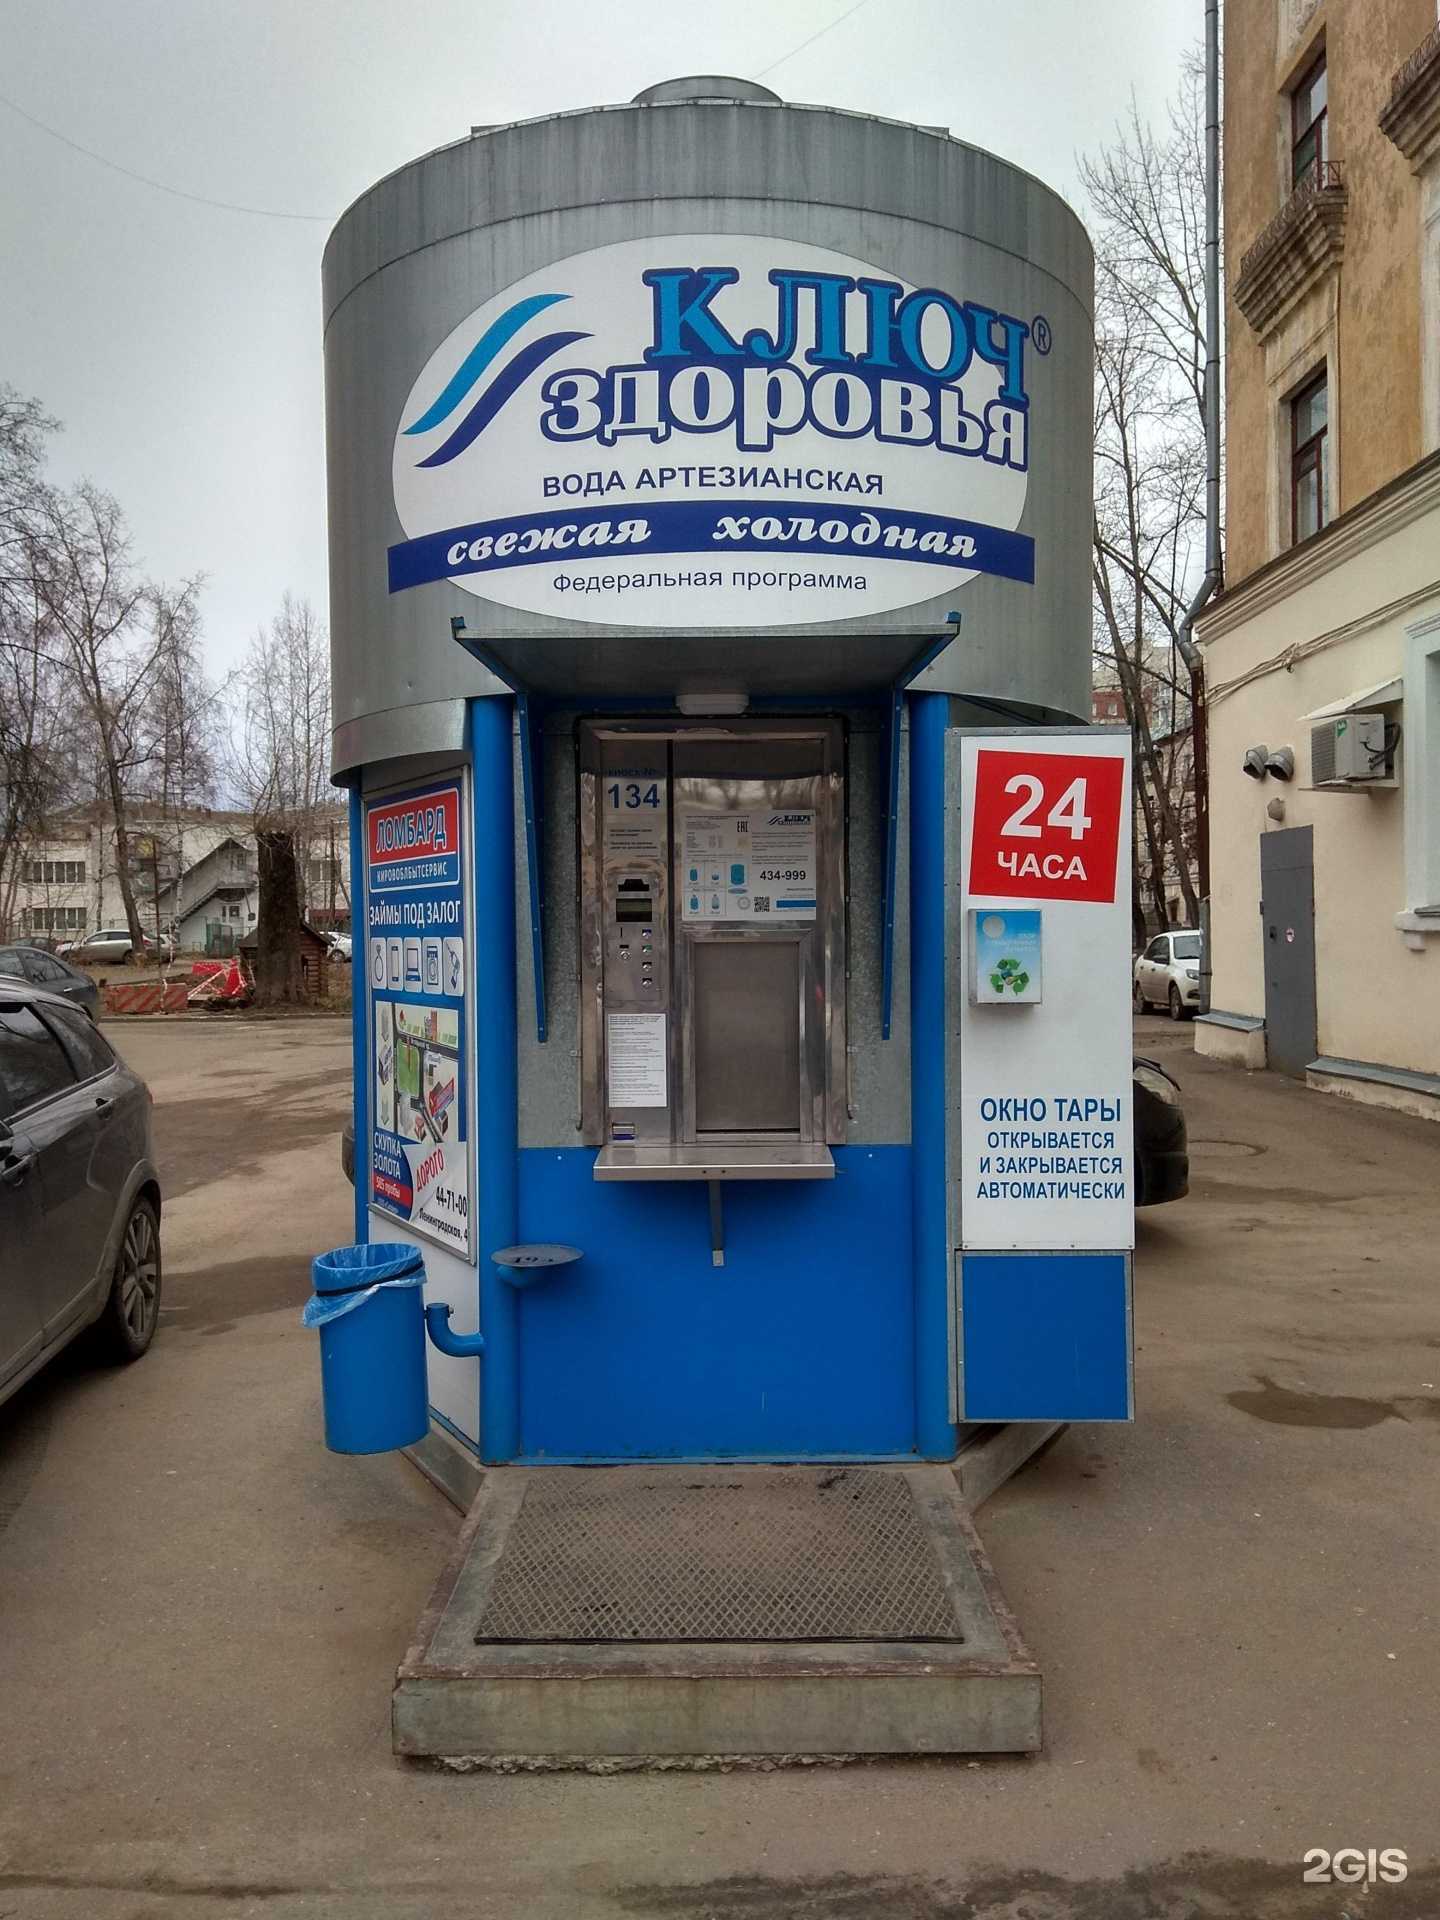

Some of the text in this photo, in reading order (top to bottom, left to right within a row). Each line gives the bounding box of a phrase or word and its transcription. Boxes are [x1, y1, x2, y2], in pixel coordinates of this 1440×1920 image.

[642, 267, 1029, 402] КЛЮЧ
[540, 363, 1028, 471] здоровья
[543, 466, 884, 497] ВОДА АРТЕЗИАНСКАЯ
[446, 512, 978, 566] свежая холодная
[552, 570, 868, 595] Федеральная программа
[607, 783, 660, 809] 134
[1000, 773, 1092, 841] 24
[376, 805, 446, 853] ЛОМБАРД
[760, 870, 806, 881] 434-999
[997, 851, 1088, 881] ЧАСА
[370, 900, 461, 928] ЗАЙМЫ ПОД ЗАЛОГ
[980, 1098, 1121, 1122] ОКНО ТАРЫ
[374, 1132, 402, 1158] СКУПКА
[987, 1131, 1115, 1149] ОТКРЫВАЕТСЯ
[373, 1152, 401, 1180] ЗОЛОТА
[416, 1148, 444, 1192] ДОРОГО
[979, 1156, 1123, 1174] И ЗАКРЫВАЕТСЯ
[435, 1186, 467, 1217] 44-71-00
[976, 1181, 1125, 1200] АВТОМАТИЧЕСКИ
